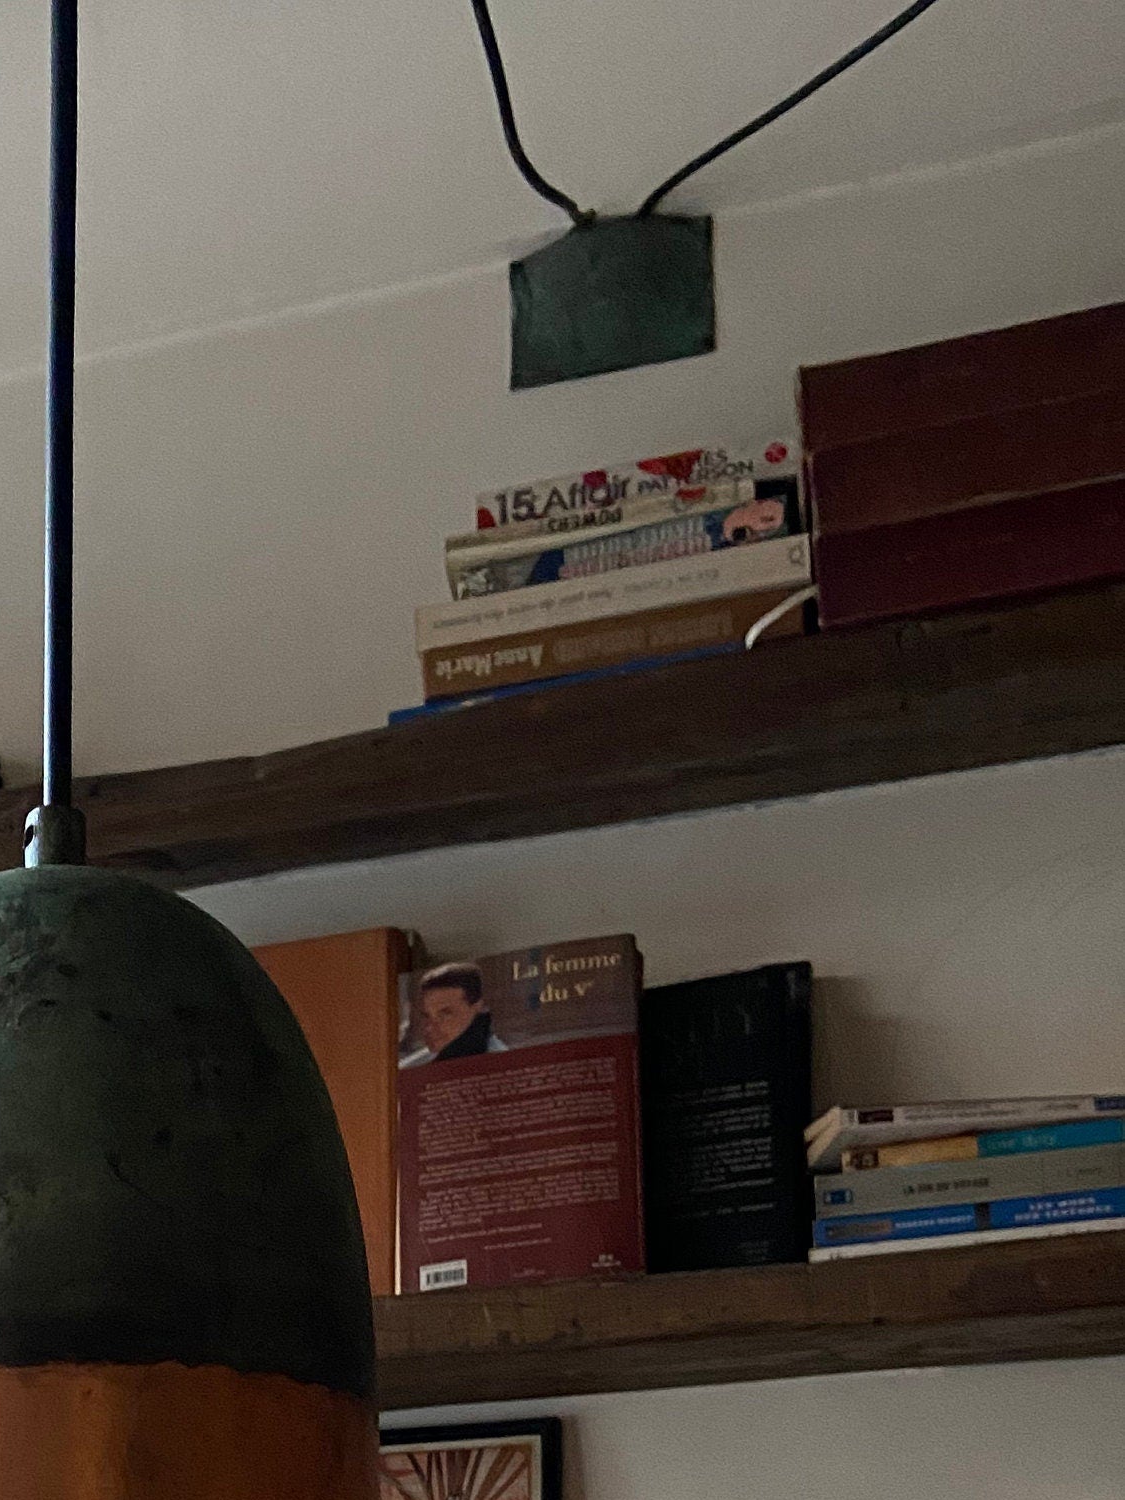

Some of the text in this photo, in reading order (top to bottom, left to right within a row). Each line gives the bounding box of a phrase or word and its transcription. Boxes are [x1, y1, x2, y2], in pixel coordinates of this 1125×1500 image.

[512, 950, 622, 982] La femme
[539, 982, 570, 1004] du
